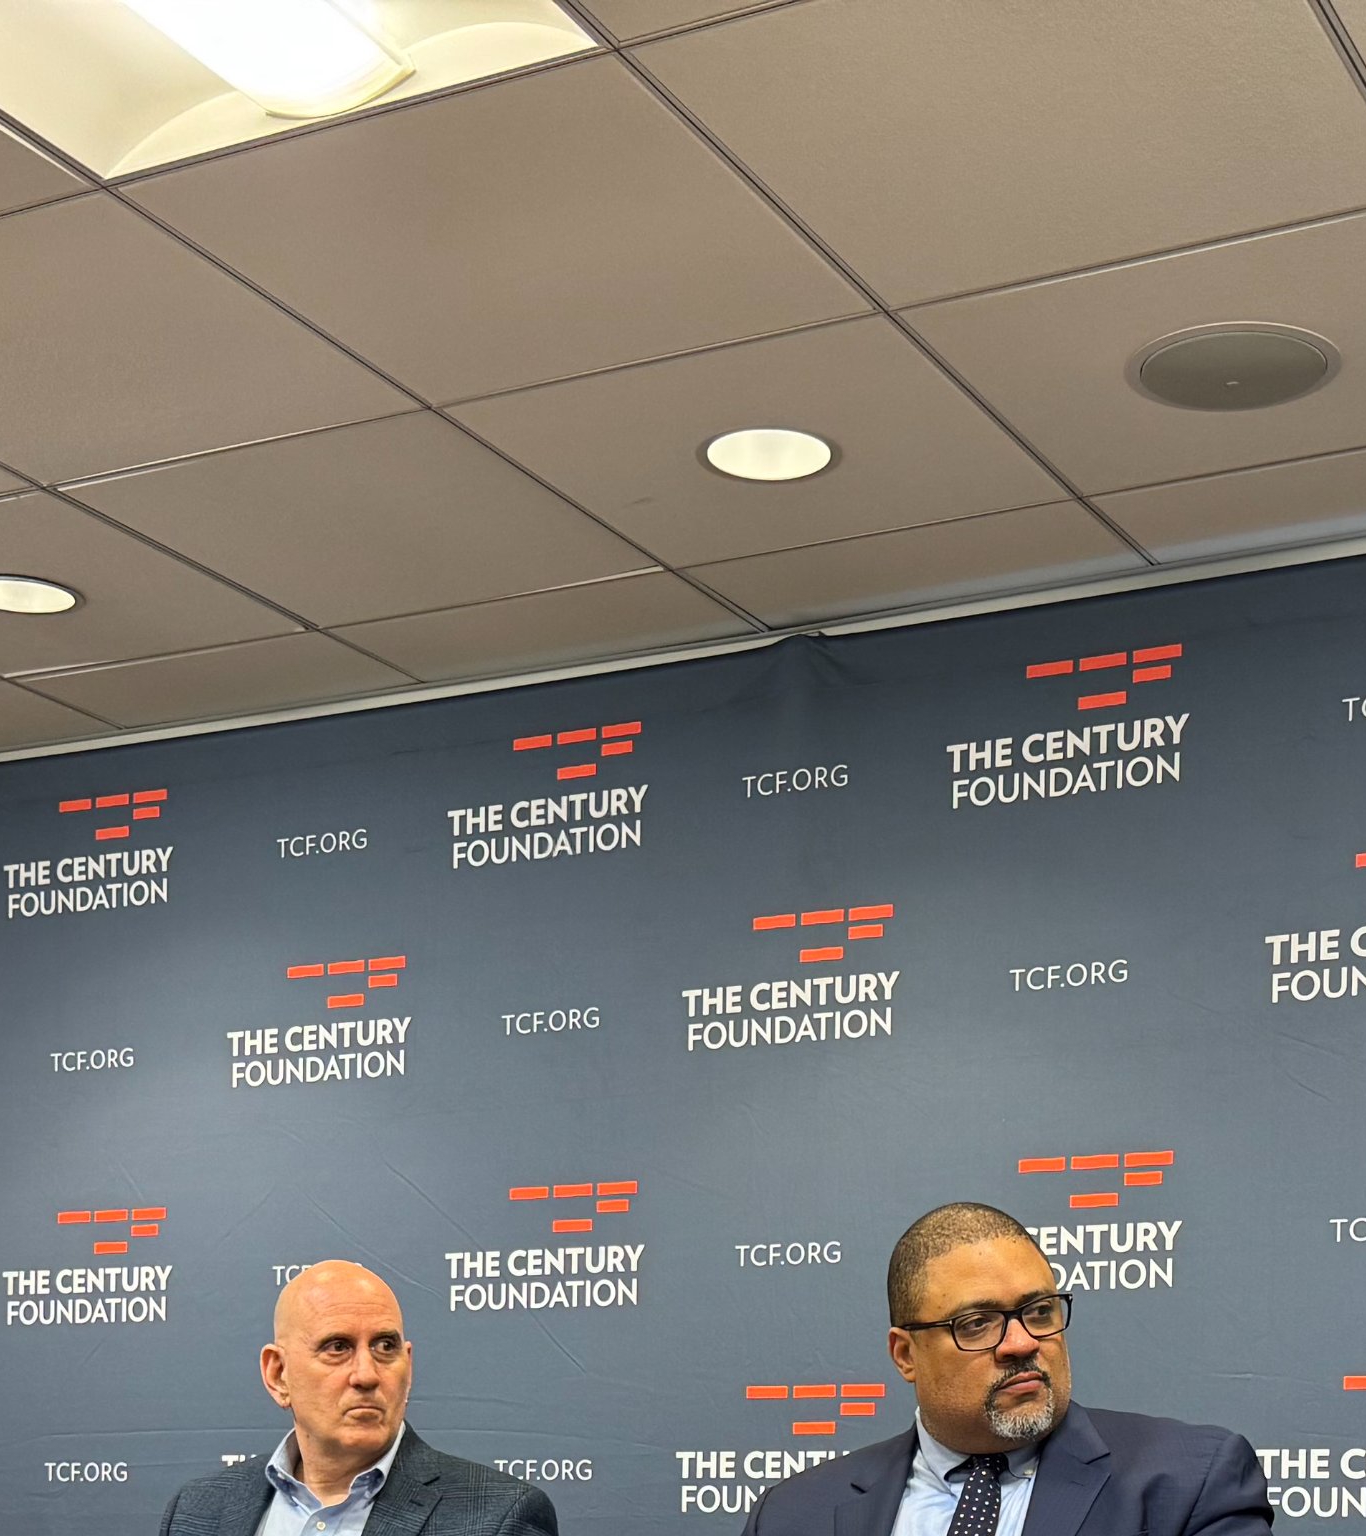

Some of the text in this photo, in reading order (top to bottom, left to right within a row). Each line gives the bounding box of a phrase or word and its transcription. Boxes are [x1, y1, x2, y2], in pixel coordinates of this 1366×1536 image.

[947, 713, 1189, 772] THE CENTURY
[743, 765, 847, 797] TCF.ORG
[953, 752, 1180, 809] FOUNDATION
[448, 785, 648, 836] THE CENTURY
[277, 829, 367, 857] TCF.ORG
[453, 820, 640, 868] FOUNDATION
[4, 847, 173, 888] THE CENTURY
[9, 878, 167, 918] FOUNDATION
[1265, 930, 1340, 965] THE
[1010, 960, 1127, 991] TCF.ORG
[682, 971, 899, 1017] THE CENTURY
[227, 1017, 411, 1056] THE CENTURY
[502, 1007, 599, 1035] TCF.ORG
[688, 1007, 891, 1051] FOUNDATION
[51, 1048, 133, 1071] TCF.ORG
[232, 1050, 404, 1088] FOUNDATION
[445, 1245, 644, 1278] THE CENTURY
[735, 1241, 840, 1266] TCF.ORG
[3, 1266, 172, 1295] THE CENTURY
[451, 1279, 637, 1311] FOUNDATION
[8, 1296, 166, 1325] FOUNDATION
[45, 1462, 127, 1481] TCF.ORG
[676, 1452, 736, 1479] THE
[1255, 1449, 1330, 1479] THE
